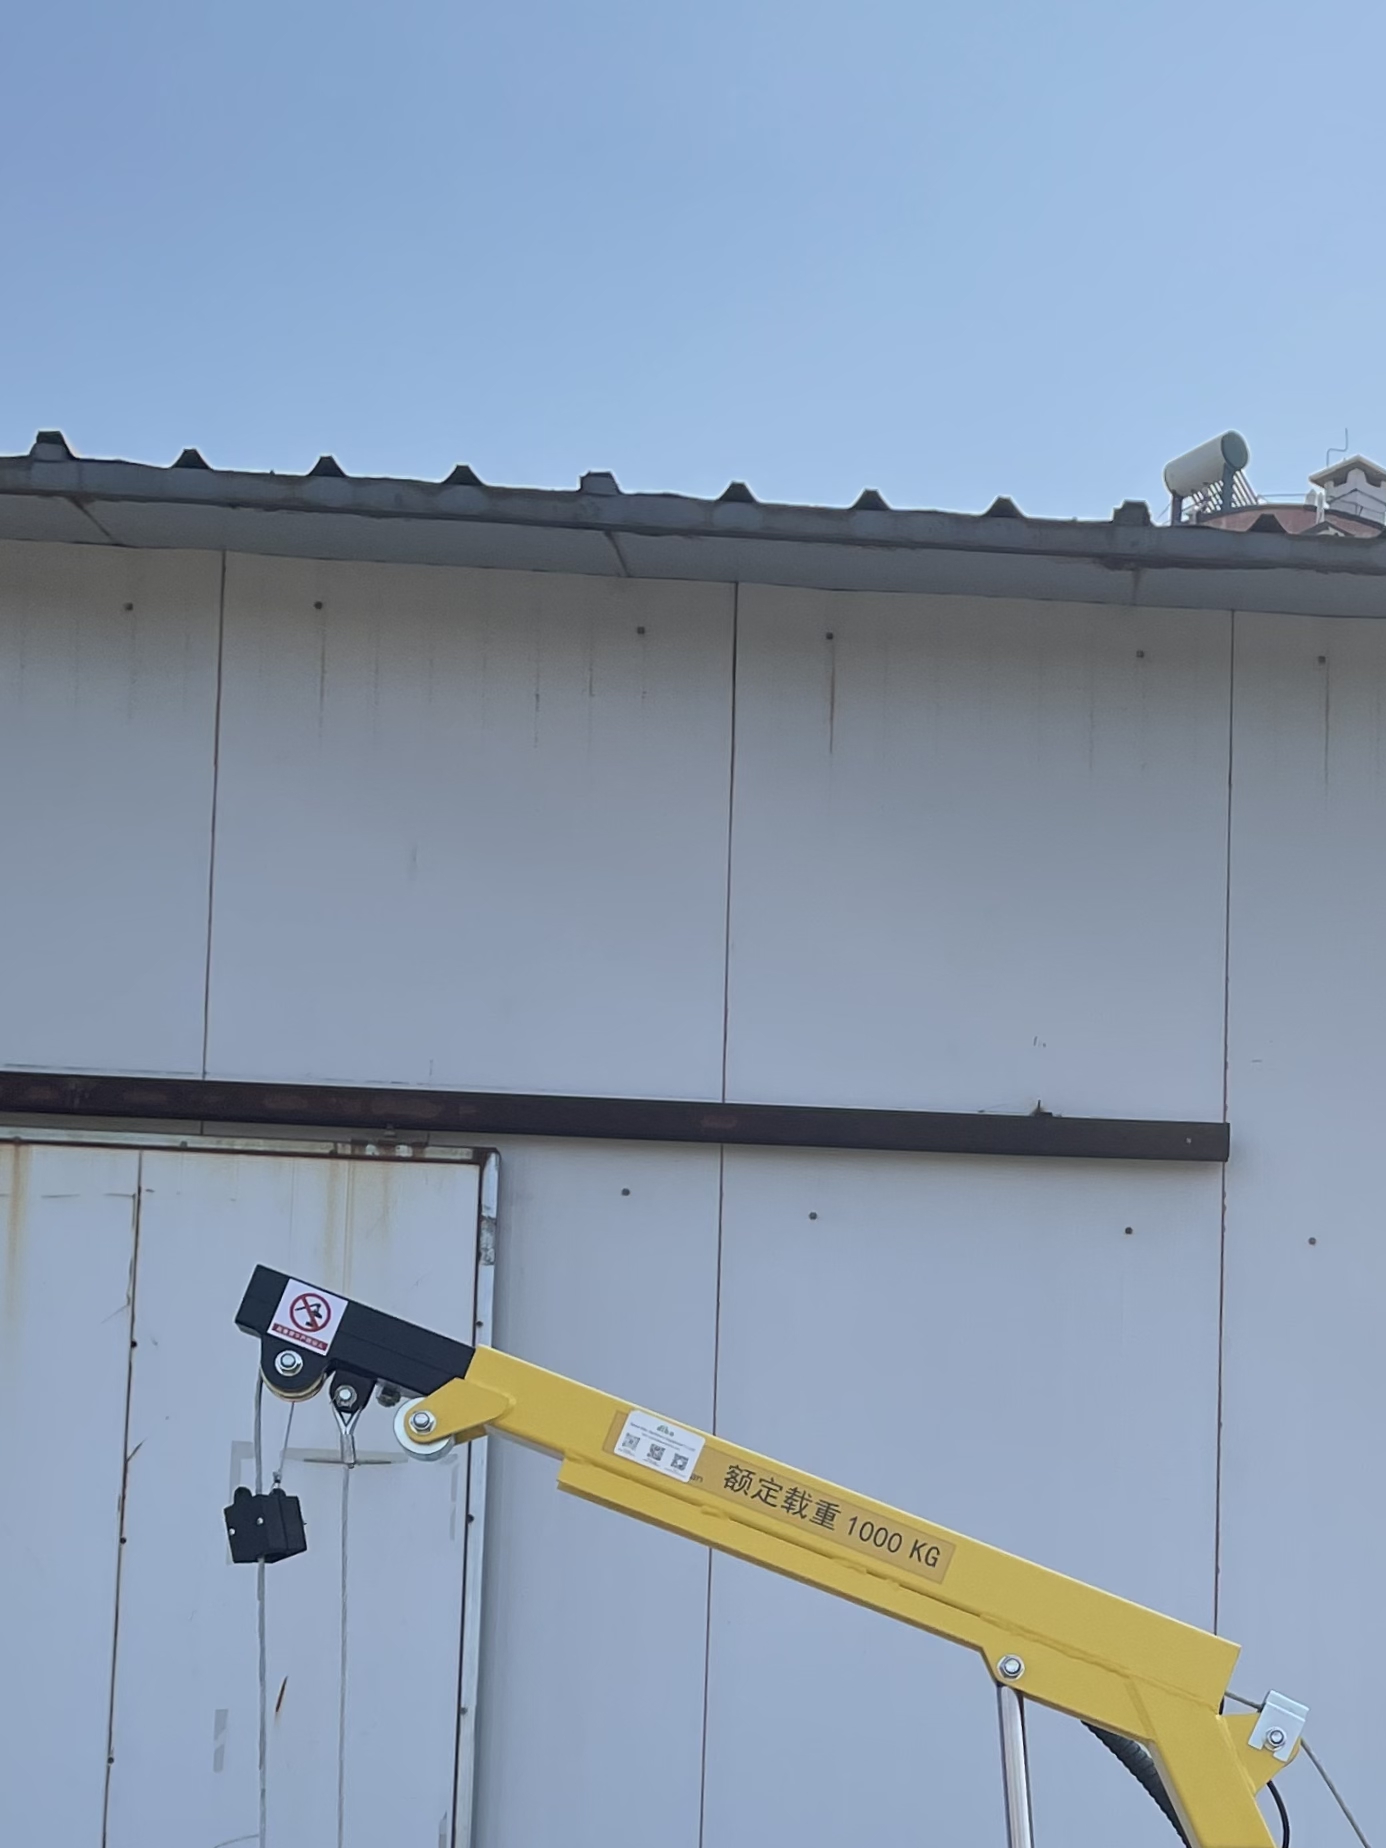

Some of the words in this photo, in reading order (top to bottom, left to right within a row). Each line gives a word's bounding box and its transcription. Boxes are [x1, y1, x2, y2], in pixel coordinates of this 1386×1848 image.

[723, 1464, 841, 1531] 额定载重
[847, 1516, 903, 1553] 1000
[909, 1539, 941, 1568] KG
